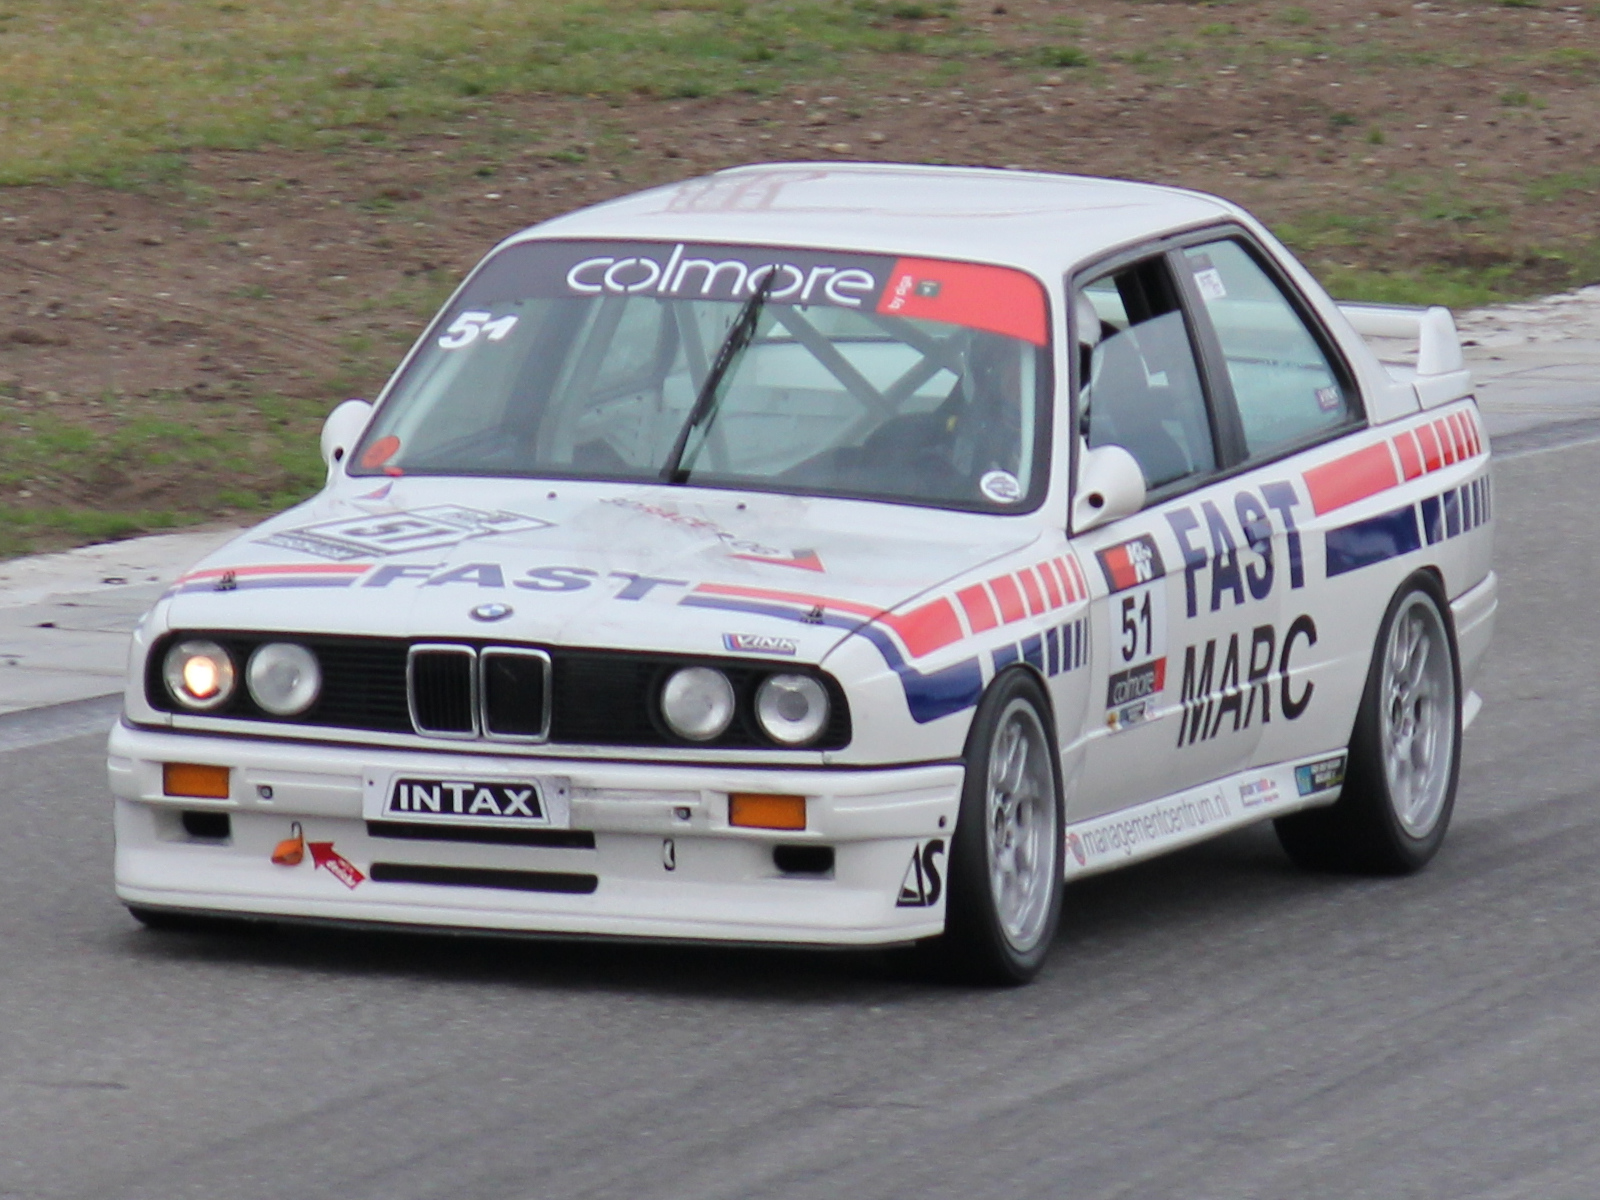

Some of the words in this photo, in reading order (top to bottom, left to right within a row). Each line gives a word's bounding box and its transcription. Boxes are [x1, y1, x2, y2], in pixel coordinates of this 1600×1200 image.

[566, 243, 875, 306] colmore
[438, 311, 519, 349] 51
[1164, 479, 1305, 619] FAST
[360, 562, 691, 601] FAST
[1121, 590, 1153, 662] 51
[1176, 613, 1318, 748] MARC
[399, 781, 534, 817] INTAX
